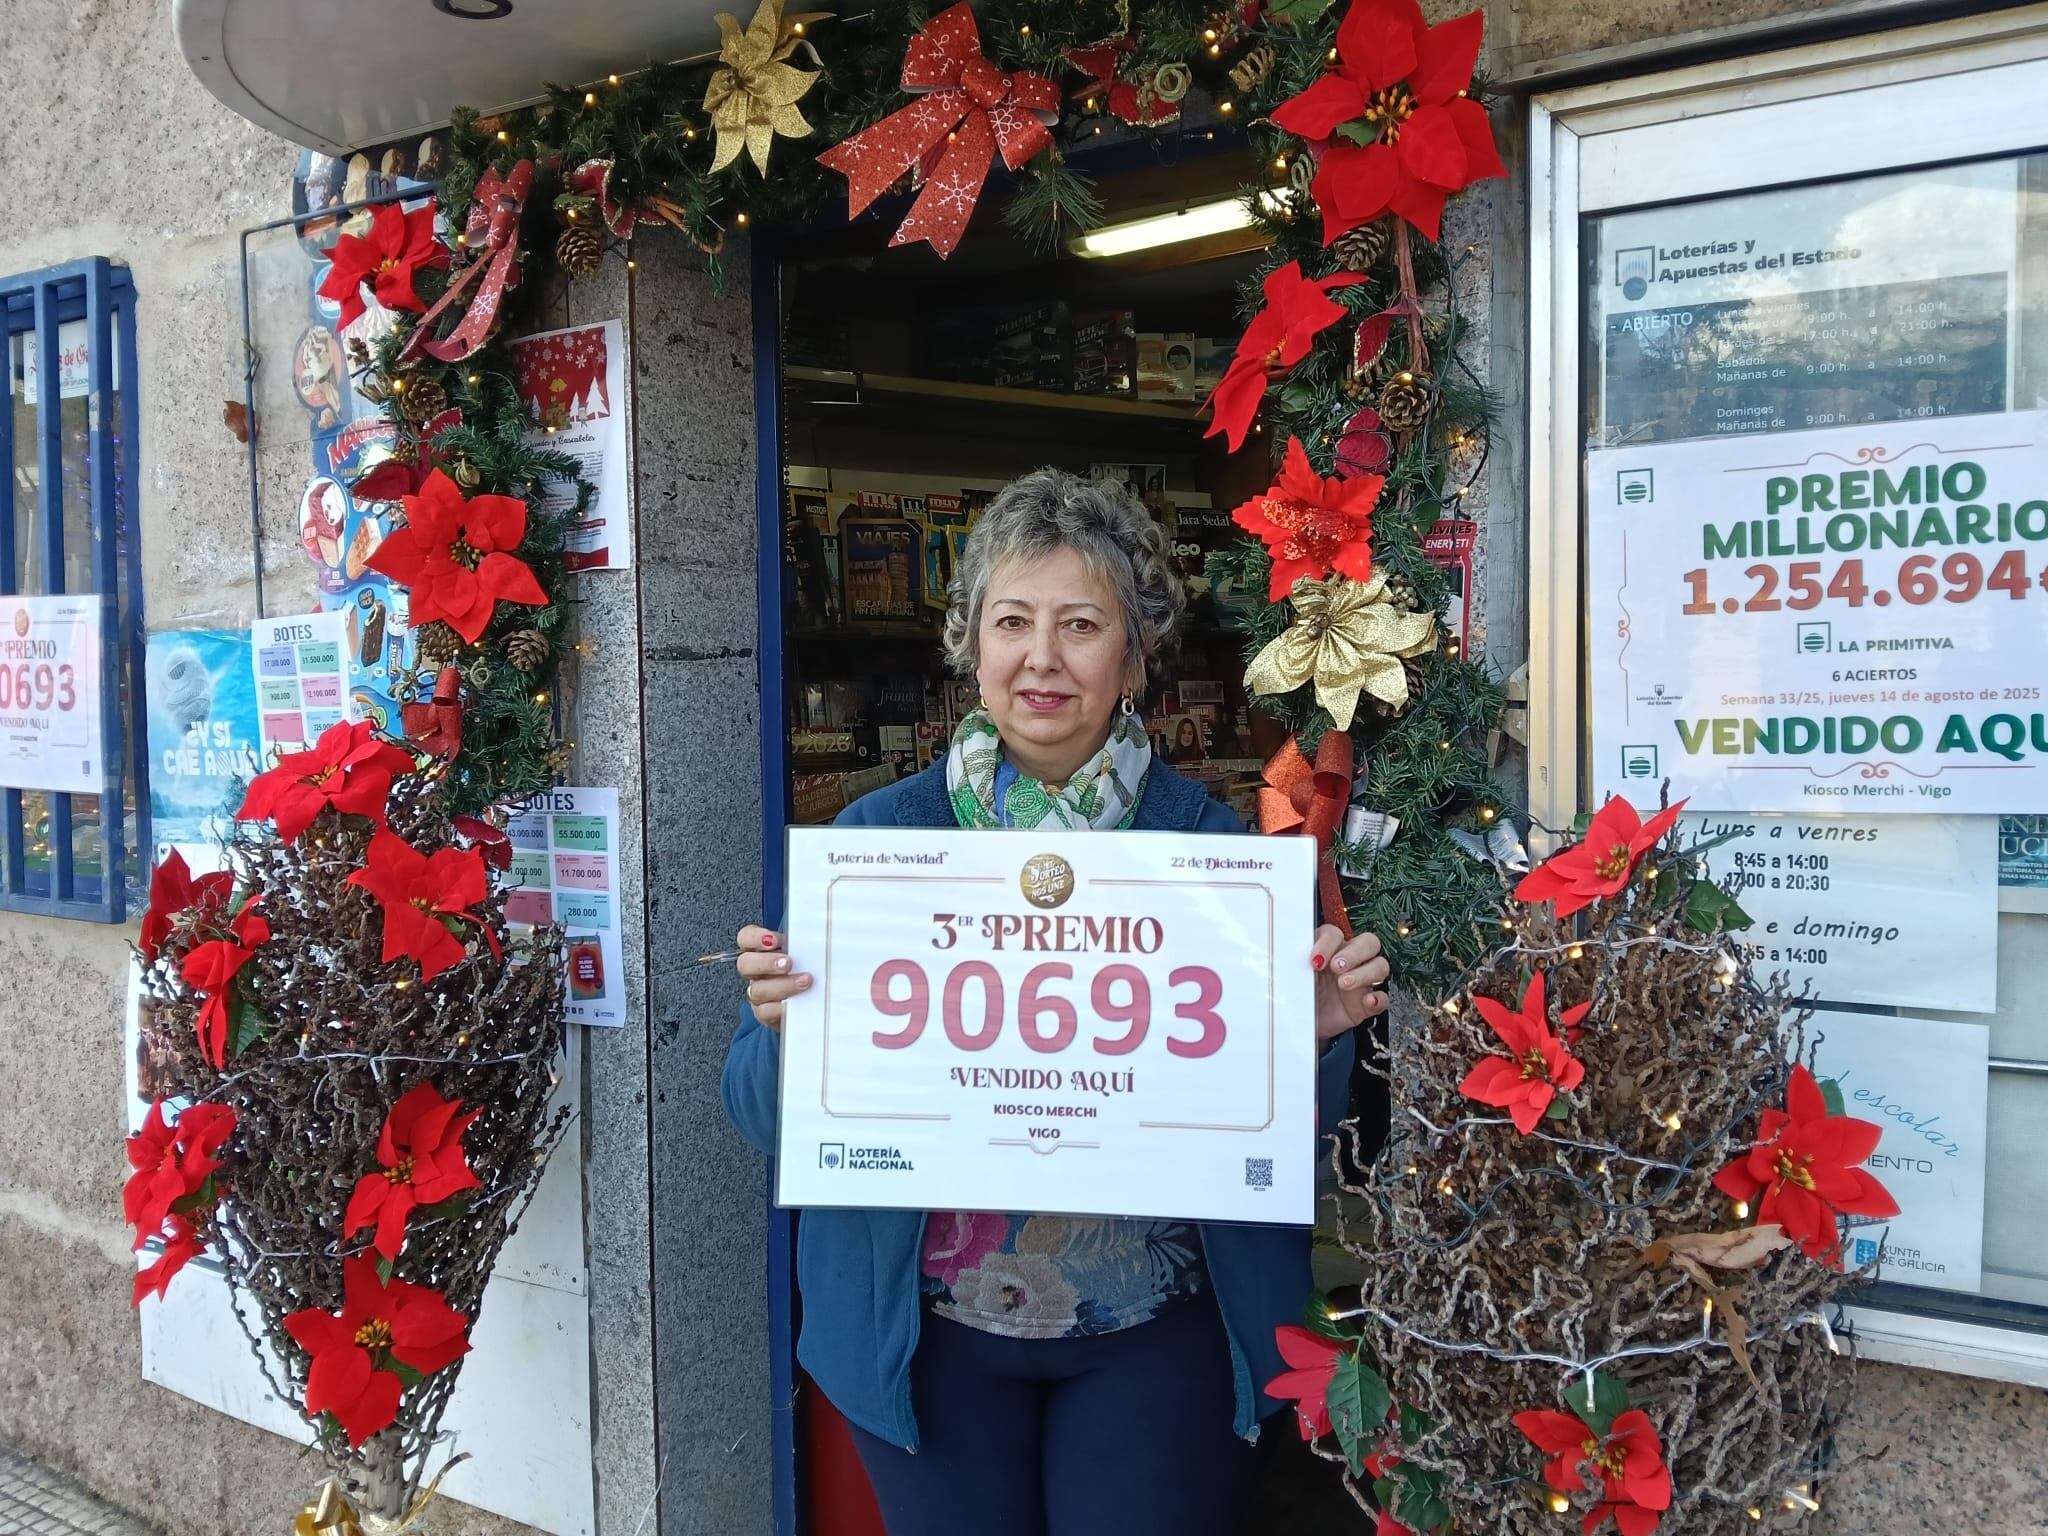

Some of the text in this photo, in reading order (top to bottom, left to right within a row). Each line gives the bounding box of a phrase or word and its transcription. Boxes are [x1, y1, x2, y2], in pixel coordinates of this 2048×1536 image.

[1659, 240, 1756, 261] Loterías y
[1658, 246, 1863, 284] Apuestas del Estado
[1807, 312, 1835, 324] 9:00
[1899, 301, 1935, 315] 14:00
[1622, 312, 1694, 332] ABIERTO
[1803, 329, 1838, 342] 17:00
[1900, 319, 1937, 332] 21:00
[1717, 370, 1769, 383] Mañanas
[1771, 367, 1787, 378] de
[1807, 363, 1835, 375] 9:00
[1868, 360, 1876, 369] a
[1899, 354, 1936, 367] 14:00
[1717, 404, 1775, 419] Domingos
[1717, 418, 1769, 432] Mañanas
[1771, 417, 1786, 428] de
[1806, 413, 1834, 425] 9:00
[1867, 412, 1876, 421] a
[1899, 405, 1935, 417] 14:00
[1766, 461, 1987, 515] PREMIO
[929, 498, 961, 511] muy
[1178, 513, 1230, 527] Jara Sedal
[856, 531, 913, 545] VIAJES
[1703, 500, 2048, 560] MILLONARIO
[855, 608, 869, 617] FIN
[870, 608, 882, 617] DE
[273, 624, 313, 643] BOTES
[5, 639, 57, 660] PREMIO
[1839, 637, 1954, 652] LA PRIMITIVA
[1832, 668, 1918, 682] 6 ACIERTOS
[1720, 686, 2040, 706] Semana 33/25, jueves 14 de agosto de 2025
[212, 720, 233, 748] SI
[1674, 714, 1923, 756] VENDIDO
[803, 736, 850, 753] 2026
[163, 749, 201, 776] CAE
[1803, 783, 1849, 796] Kiosco
[1854, 783, 1904, 797] Merchi
[1918, 783, 1951, 799] Vigo
[559, 830, 600, 839] 55.500.000
[1701, 818, 1878, 842] Luns a venres
[877, 853, 891, 864] de
[893, 852, 949, 865] Navidad
[1171, 857, 1273, 870] 22 de Diciembre
[1734, 852, 1829, 870] 8:45 a 14:00
[561, 869, 602, 879] 11.700.000
[1030, 863, 1066, 883] SORTEO
[1031, 879, 1065, 898] NOS UNE
[1771, 876, 1781, 889] a
[1786, 874, 1830, 891] 20:30
[568, 907, 598, 917] 280.000
[981, 914, 1164, 954] PREMIO
[1766, 921, 1778, 934] e
[1793, 915, 1900, 945] domingo
[1770, 949, 1780, 962] a
[1786, 946, 1828, 964] 14:00
[870, 959, 1227, 1059] 90693
[950, 1066, 1135, 1096] VENDIDO AQUÍ
[994, 1104, 1097, 1118] KIOSCO MERCHI
[1854, 1088, 1960, 1158] escolar
[1028, 1128, 1060, 1139] VIGO
[849, 1147, 901, 1159] LOTERÍA
[849, 1159, 914, 1171] NACIONAL
[1881, 1245, 1921, 1259] XUNTA
[1881, 1257, 1945, 1273] DE GALICIA
